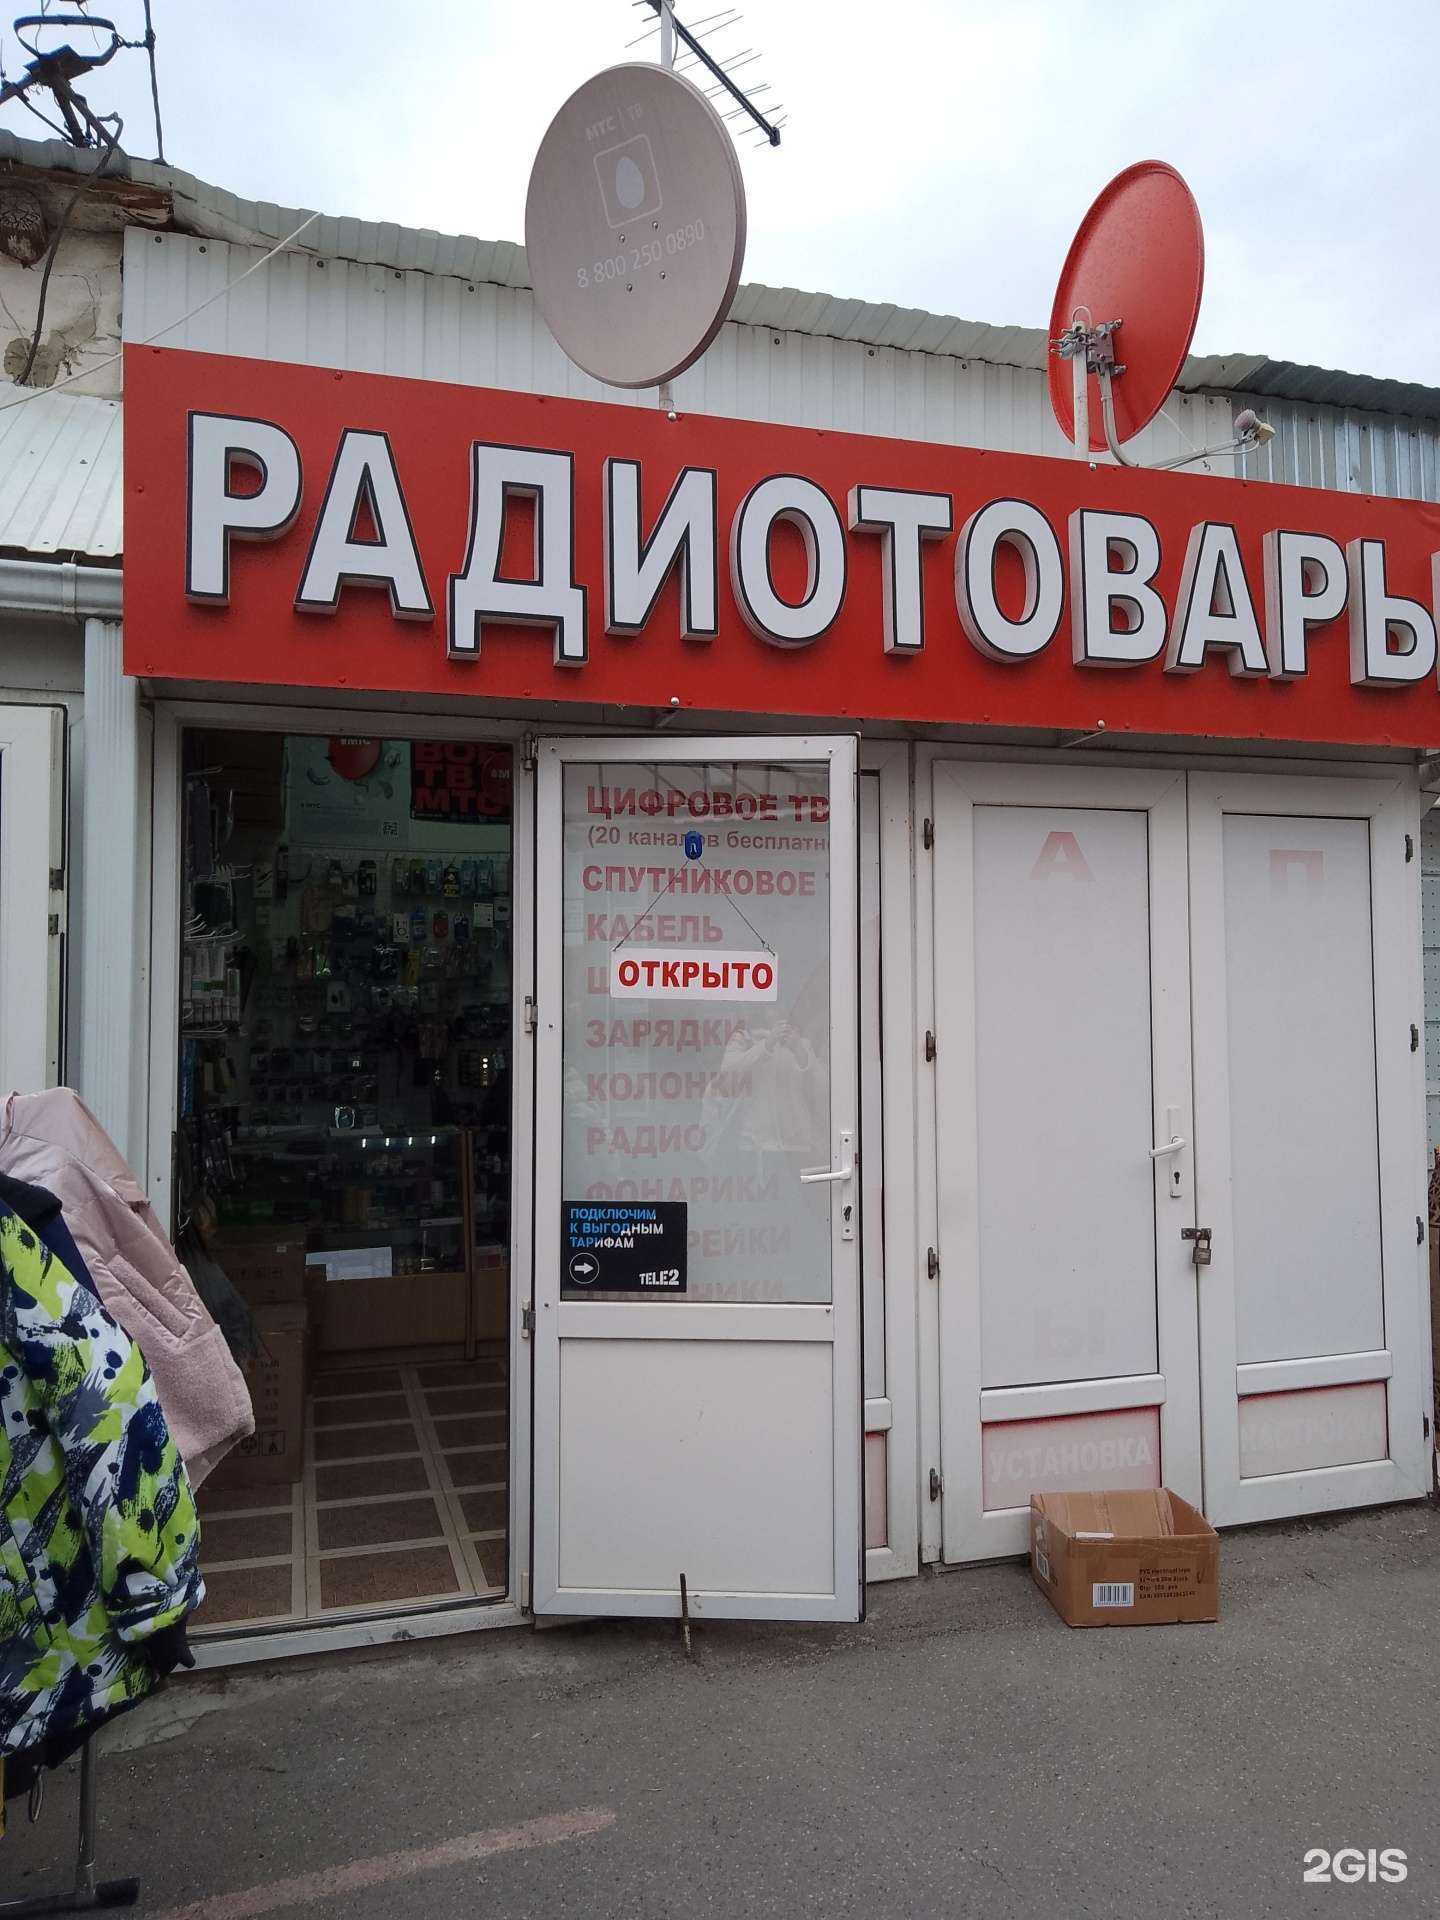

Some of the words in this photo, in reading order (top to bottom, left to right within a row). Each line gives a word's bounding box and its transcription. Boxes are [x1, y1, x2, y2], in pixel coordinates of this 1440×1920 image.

[577, 267, 589, 288] 8
[594, 255, 626, 283] 800
[631, 240, 661, 270] 250
[586, 785, 778, 821] ЦИФРОВОЕ
[587, 826, 620, 848] (20
[727, 831, 830, 850] бесплатн
[582, 865, 816, 896] СПУТНИКОВОЕ
[586, 913, 724, 943] КАБЕЛЬ
[618, 960, 773, 990] ОТКРЫТО
[585, 1018, 752, 1051] ЗАРЯДКИ
[586, 1072, 754, 1102] КОЛОНКИ
[586, 1125, 707, 1158] РАДИО
[569, 1223, 578, 1233] К
[582, 1223, 664, 1236] ВЫГОДНЫМ
[570, 1208, 657, 1222] ПОДКЛЮЧИМ
[569, 1237, 634, 1249] ТАРИФАМ
[639, 1269, 680, 1286] TELE2
[988, 1436, 1154, 1483] УСТАНОВКА
